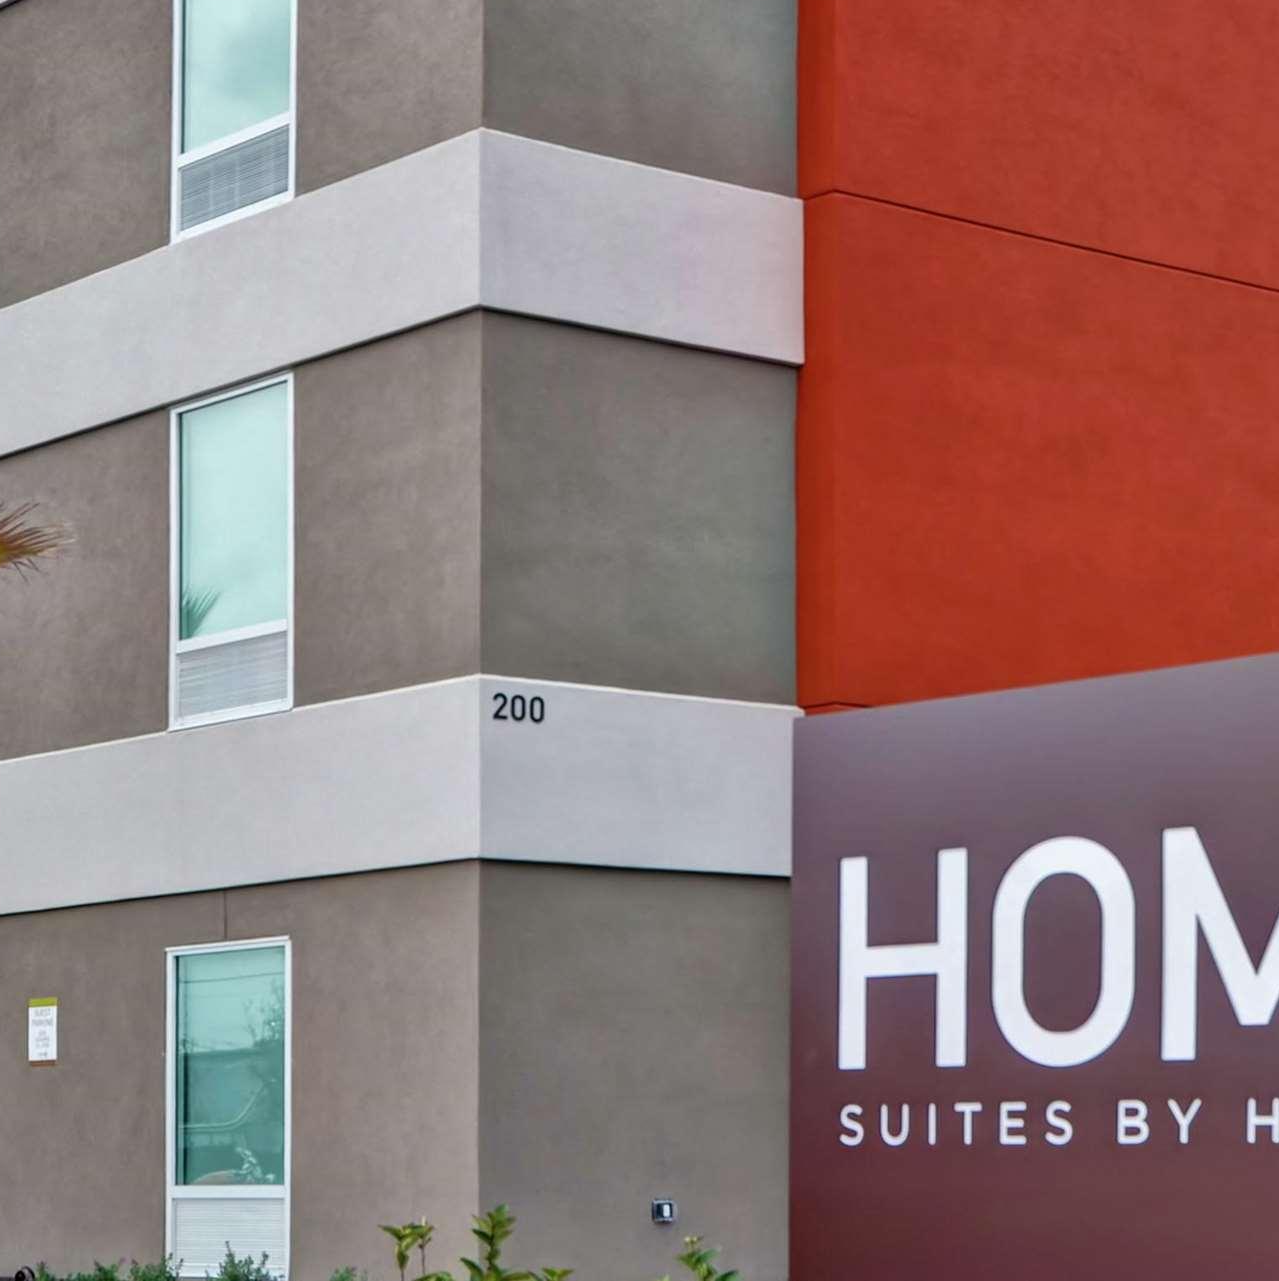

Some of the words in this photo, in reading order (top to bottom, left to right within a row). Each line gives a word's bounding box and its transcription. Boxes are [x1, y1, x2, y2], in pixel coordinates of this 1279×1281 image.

[492, 692, 545, 724] 200
[838, 1099, 1076, 1148] SUITES
[1118, 1097, 1203, 1145] BY
